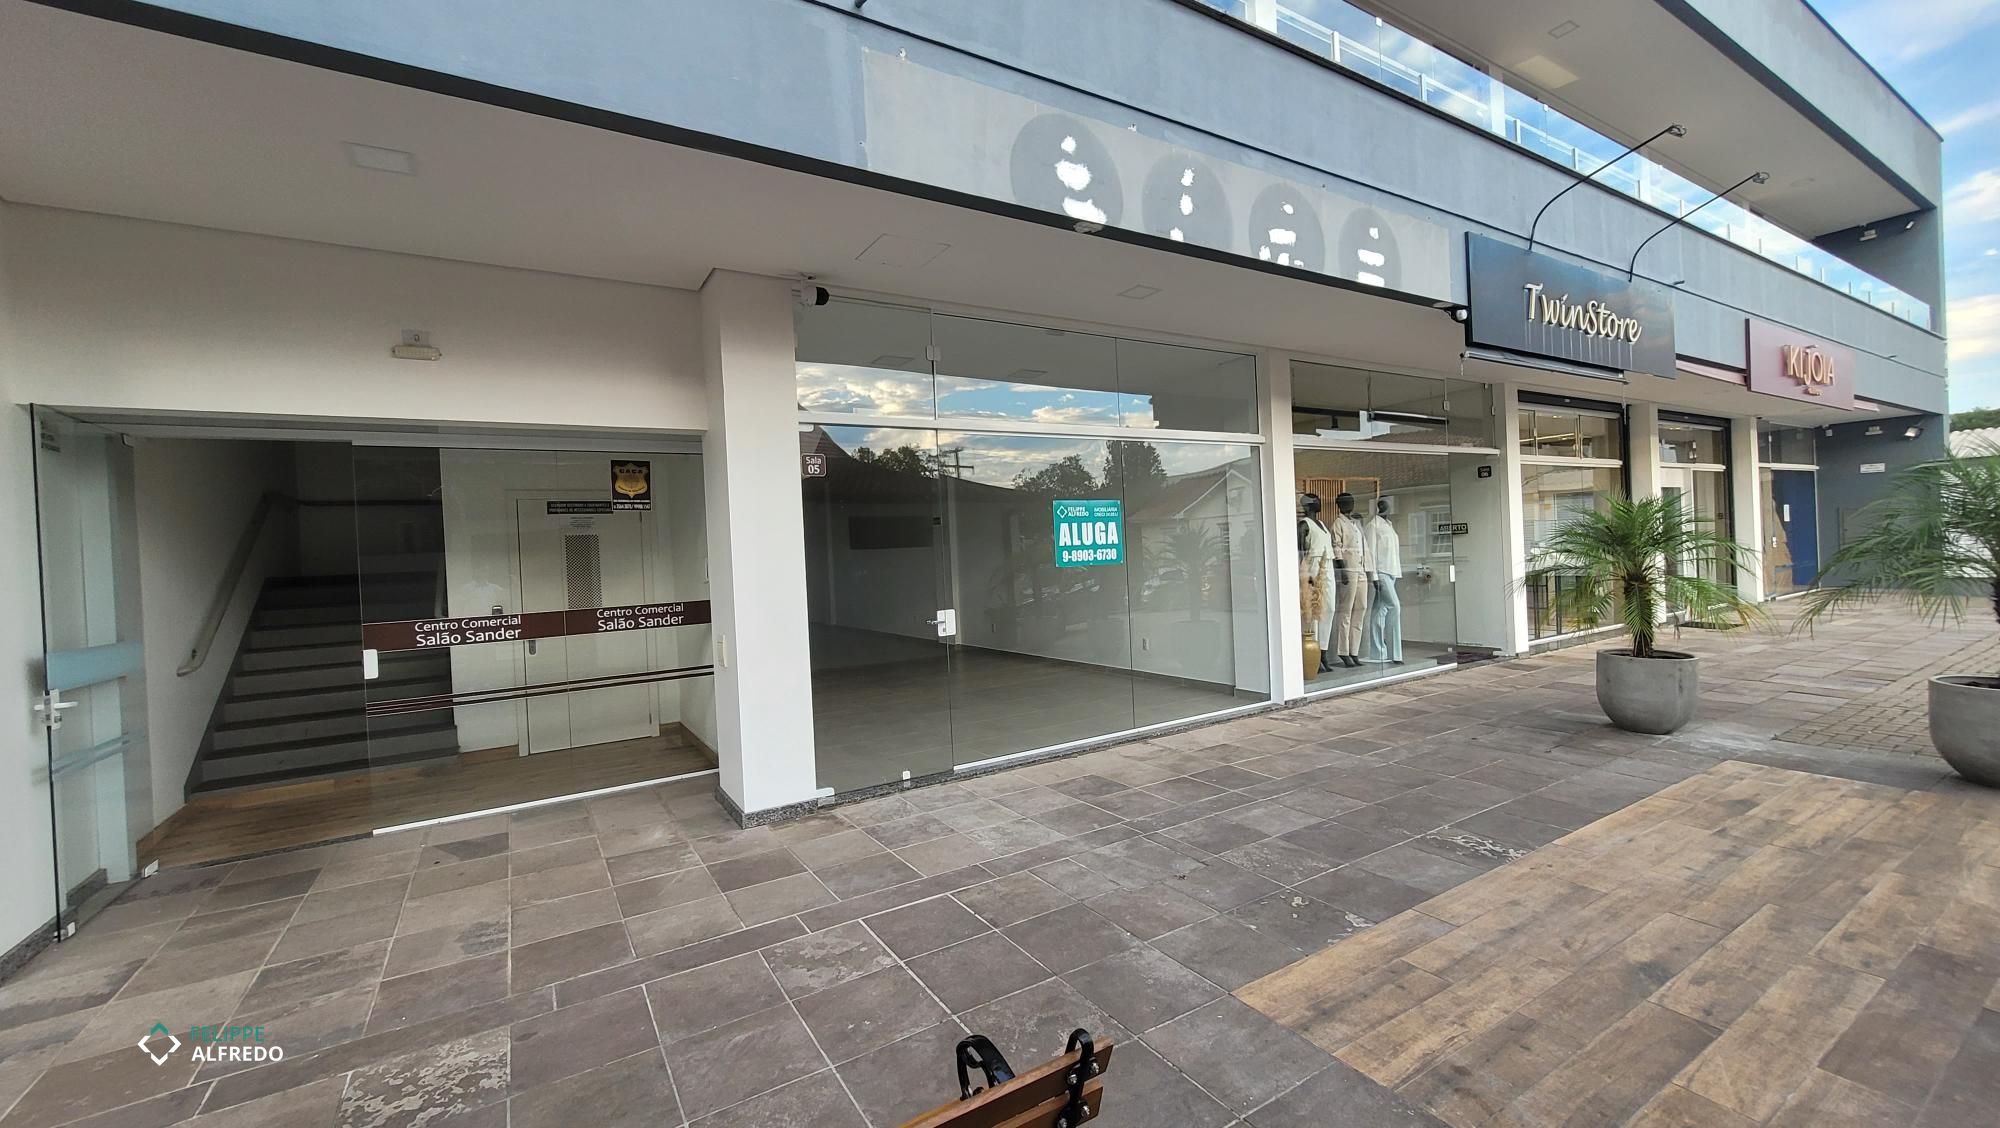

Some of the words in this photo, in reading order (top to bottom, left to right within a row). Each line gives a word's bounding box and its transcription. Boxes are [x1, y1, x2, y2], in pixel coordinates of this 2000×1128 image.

[1524, 282, 1642, 344] TwinStore
[805, 456, 822, 465] Sala
[807, 464, 820, 474] 05
[1059, 522, 1119, 547] ALUGA
[1062, 548, 1117, 563] 9-8903-6730
[597, 608, 633, 618] Centro
[634, 603, 684, 615] Comercial
[414, 621, 459, 632] Centro
[461, 615, 521, 629] Comercial
[598, 617, 635, 631] Salão
[638, 614, 684, 628] Sander
[416, 632, 461, 647] Salão
[465, 628, 522, 643] Sander
